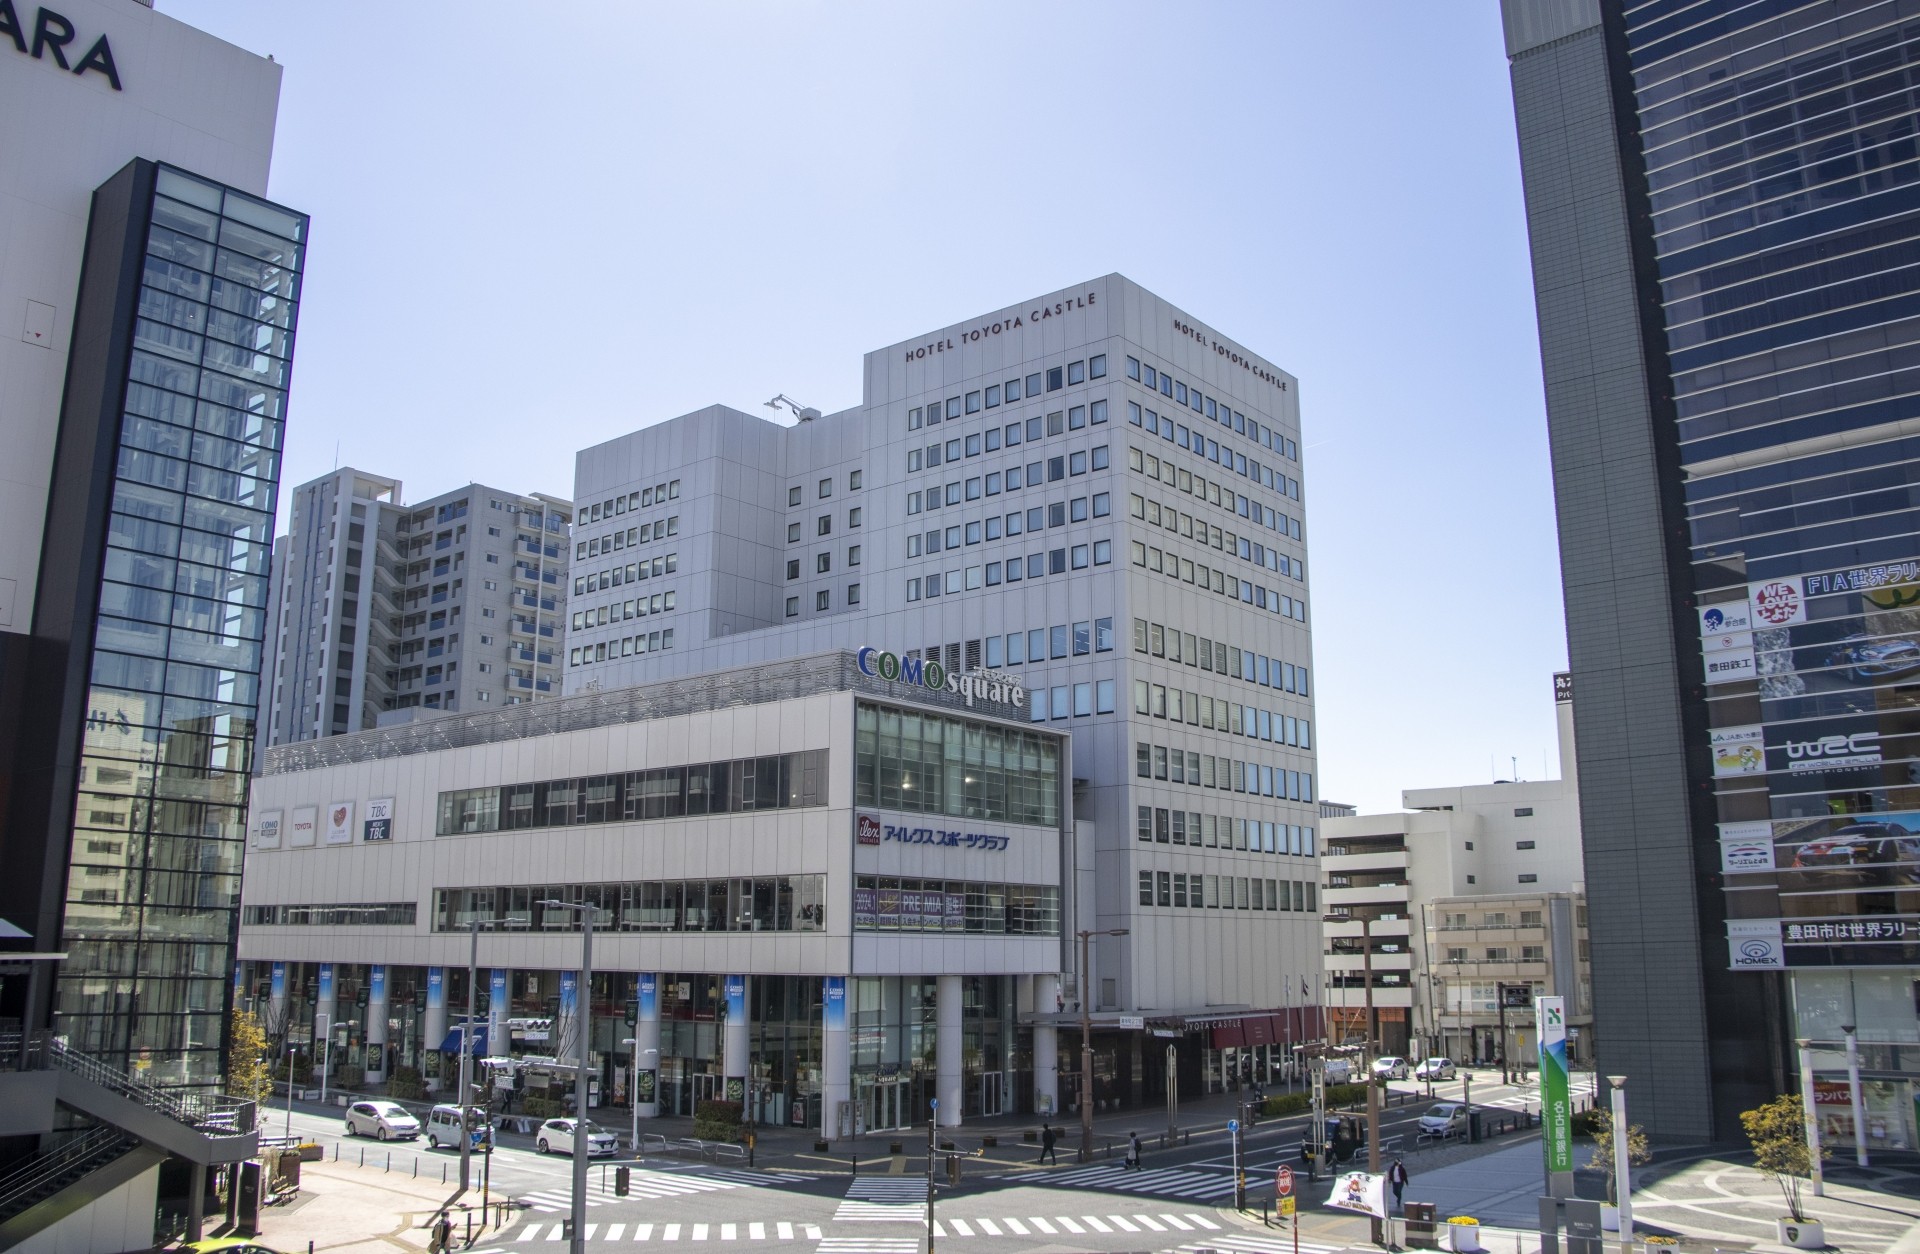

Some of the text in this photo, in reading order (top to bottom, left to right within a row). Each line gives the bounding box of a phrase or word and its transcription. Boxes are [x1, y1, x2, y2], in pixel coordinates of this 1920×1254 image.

[905, 292, 1096, 363] HOTEL TOYOTA CASTLE
[1174, 319, 1287, 392] HOTEL TOYOTA CASTLE
[1807, 562, 1920, 595] FIA世界ラリ
[1762, 583, 1790, 598] WE
[1709, 659, 1752, 672] 豊田鉄工
[857, 646, 1024, 707] COMO square
[1808, 760, 1843, 768] WORLD
[1845, 757, 1879, 765] RALLY
[1792, 765, 1880, 777] CHAMPIONSHIP
[371, 805, 387, 818] TBC
[294, 822, 312, 831] TOYOTA
[369, 827, 386, 840] TBC
[859, 820, 880, 838] ilex
[1787, 922, 1920, 940] 豊田市は世界ラリー
[1735, 957, 1778, 965] HOMEX
[1212, 1019, 1241, 1029] CASTLE
[1553, 1100, 1567, 1167] 名古屋銀行
